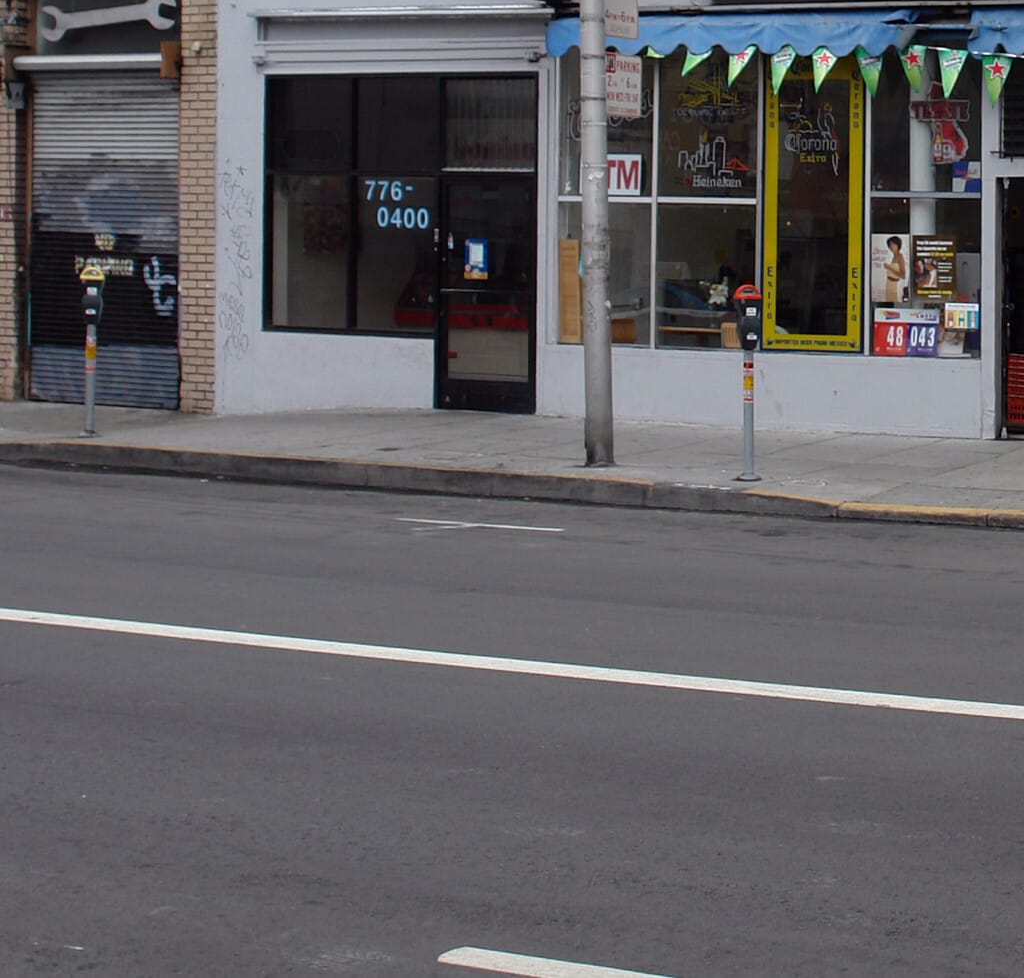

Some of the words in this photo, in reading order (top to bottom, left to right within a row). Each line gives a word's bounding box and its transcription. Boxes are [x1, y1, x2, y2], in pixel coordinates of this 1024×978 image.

[616, 60, 640, 73] PARKING
[784, 133, 838, 153] Corona
[800, 153, 827, 163] Extra
[607, 160, 639, 190] TM
[692, 174, 742, 188] Heineken
[365, 180, 413, 201] 776-
[377, 207, 429, 229] 0400
[886, 325, 904, 346] 48
[910, 326, 935, 347] 043
